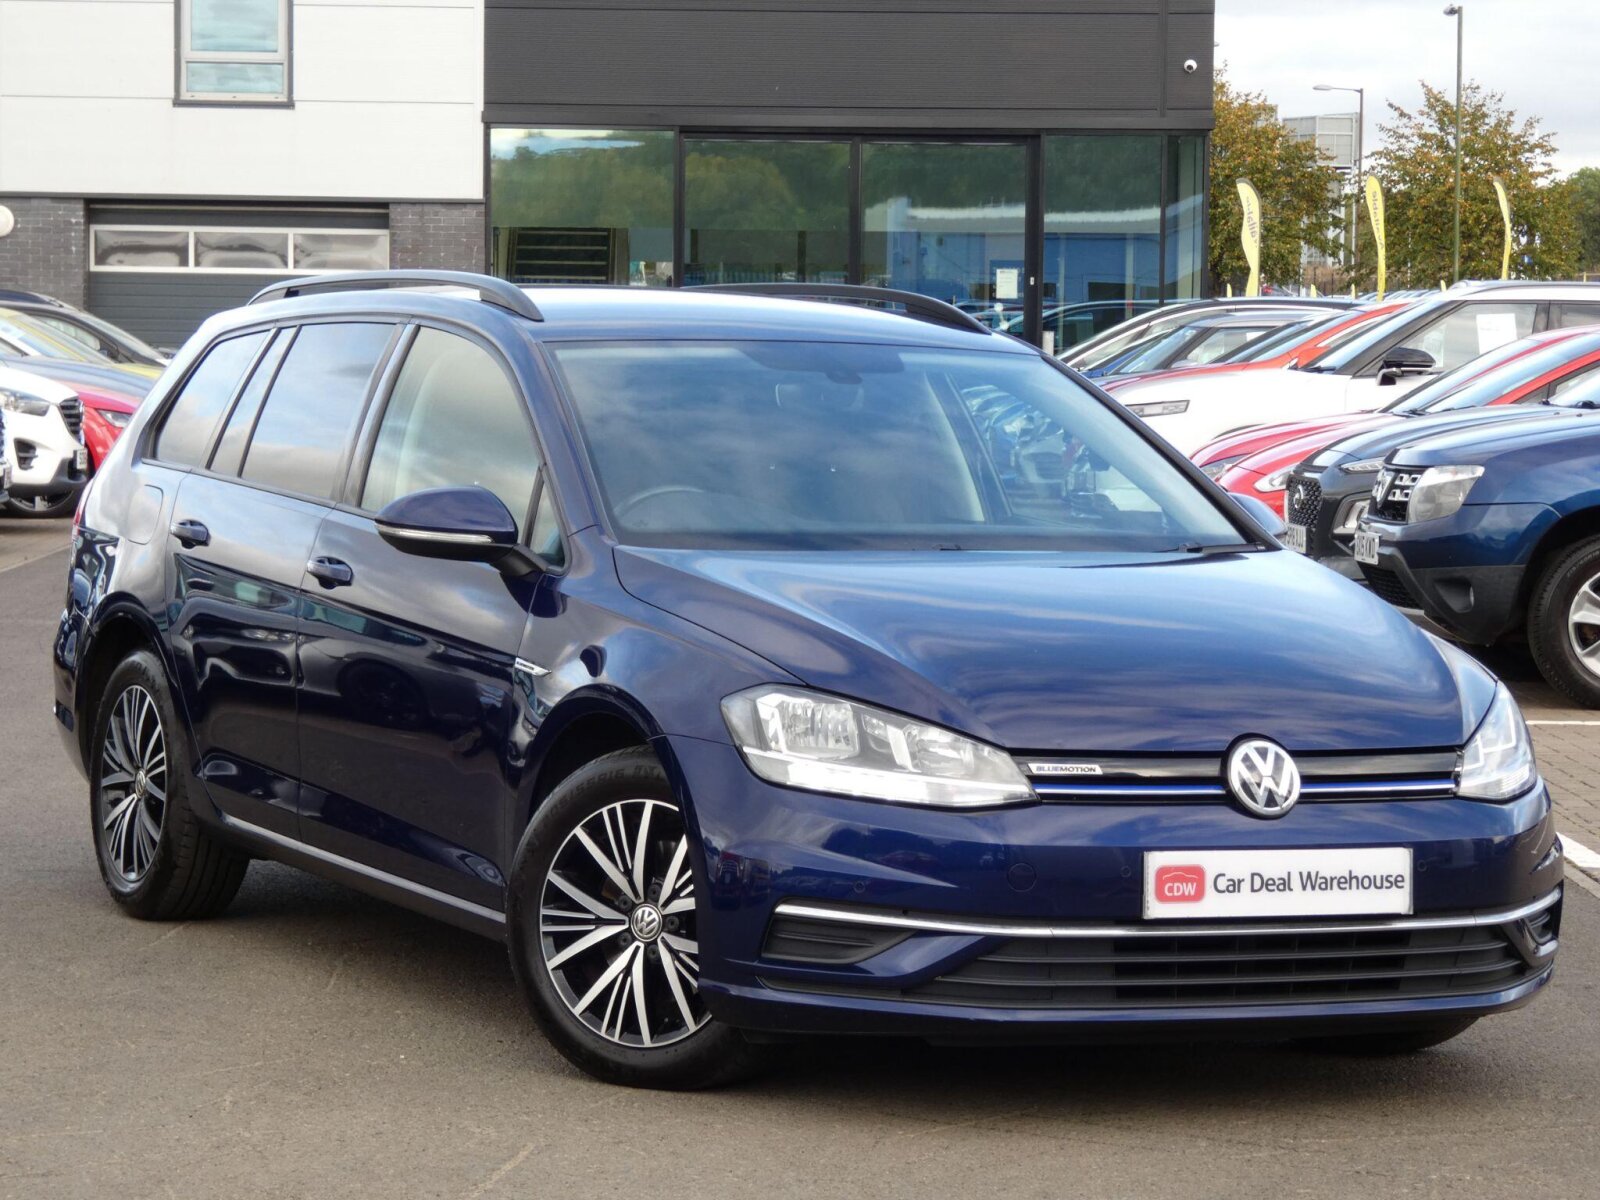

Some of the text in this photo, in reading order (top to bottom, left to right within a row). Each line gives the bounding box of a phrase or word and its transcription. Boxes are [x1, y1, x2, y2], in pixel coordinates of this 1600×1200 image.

[1035, 765, 1097, 773] BLUEMOTION
[1164, 882, 1197, 897] CDW
[1212, 870, 1405, 894] Car Deal Warehouse
